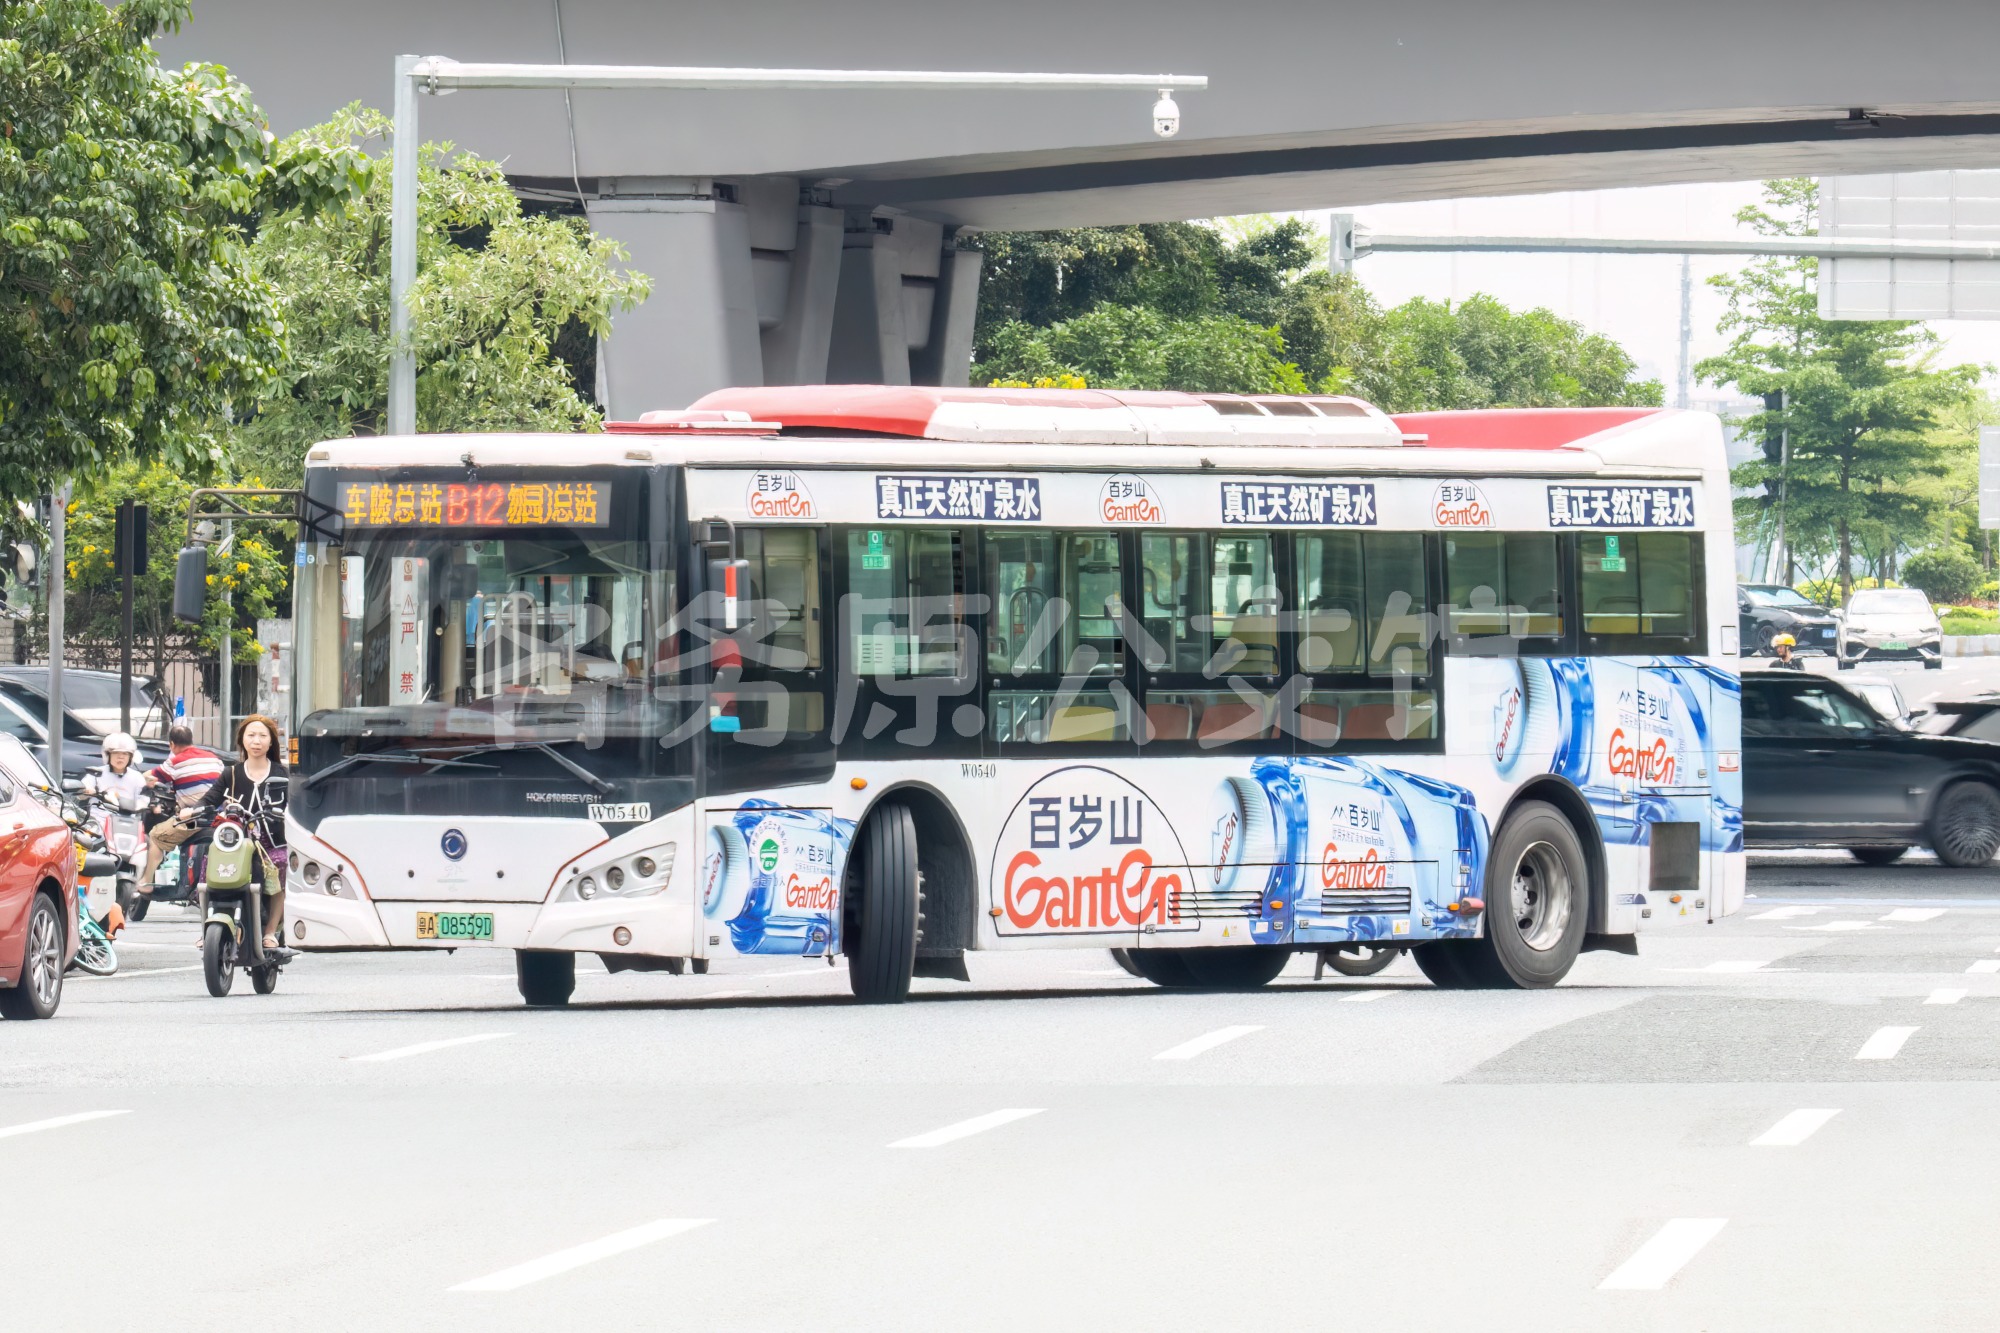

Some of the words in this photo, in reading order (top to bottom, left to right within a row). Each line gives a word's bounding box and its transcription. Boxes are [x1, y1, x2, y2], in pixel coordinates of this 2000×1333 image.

[757, 474, 797, 492] 百岁山
[878, 476, 1040, 520] 真正天然矿泉水
[1108, 481, 1146, 498] 百岁山
[1441, 486, 1476, 502] 百岁山
[344, 484, 443, 524] 车陂总站
[446, 484, 505, 525] B12
[750, 492, 811, 518] Ganten
[1103, 497, 1160, 522] Ganten
[1223, 483, 1376, 525] 真正天然矿泉水
[1435, 502, 1490, 526] Ganten
[1549, 486, 1694, 527] 真正天然矿泉水
[1636, 688, 1669, 721] 百岁山
[961, 763, 997, 779] W0540
[1608, 728, 1675, 785] Ganten
[590, 804, 648, 820] W0540
[1029, 794, 1143, 850] 百岁山
[1348, 803, 1381, 832] 百岁山
[808, 844, 832, 865] 百岁山
[1321, 842, 1387, 889] Ganten
[786, 872, 838, 911] Ganten
[1004, 848, 1183, 929] Ganten
